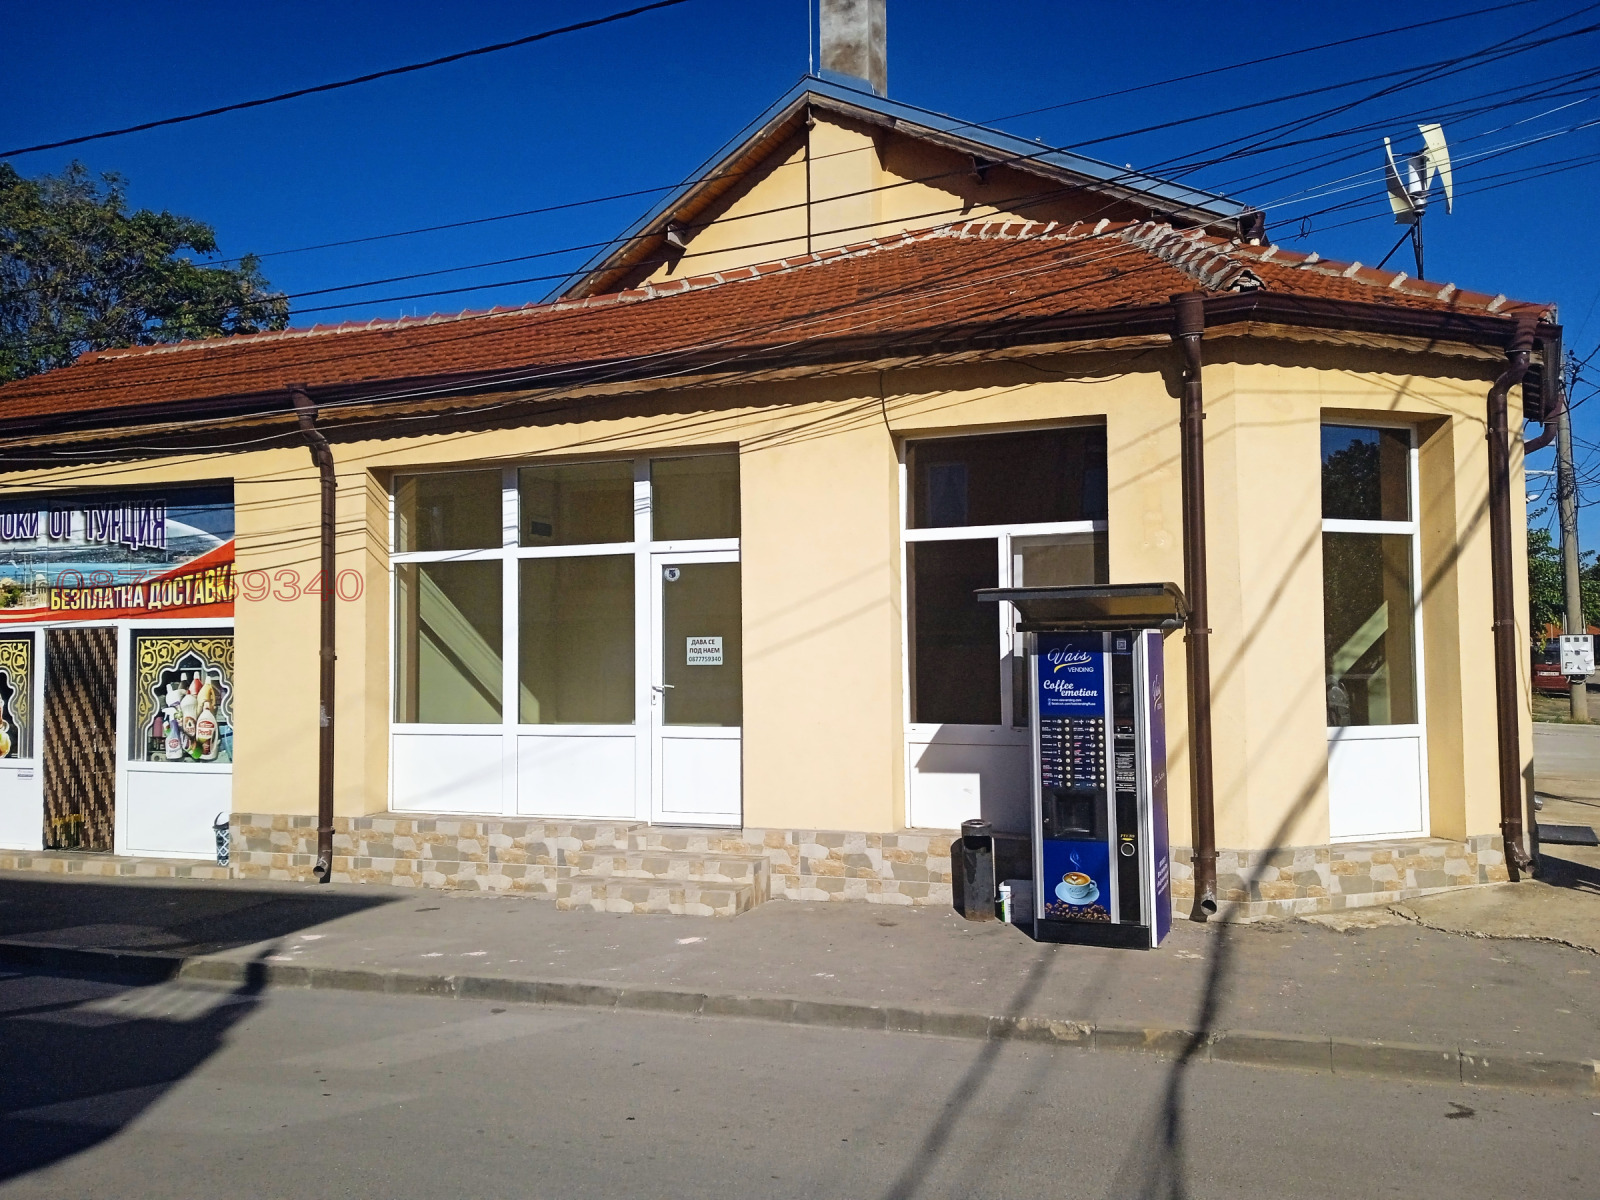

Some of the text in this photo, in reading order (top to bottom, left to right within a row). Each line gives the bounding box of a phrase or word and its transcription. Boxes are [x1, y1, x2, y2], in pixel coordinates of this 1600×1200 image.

[50, 507, 75, 539] ОТ
[84, 499, 166, 550] ТУРЦИЯ
[50, 583, 145, 610] БЕЗПЛАТНА
[1047, 643, 1091, 665] Vais
[1043, 679, 1074, 692] Coffee
[1060, 688, 1098, 697] emotion
